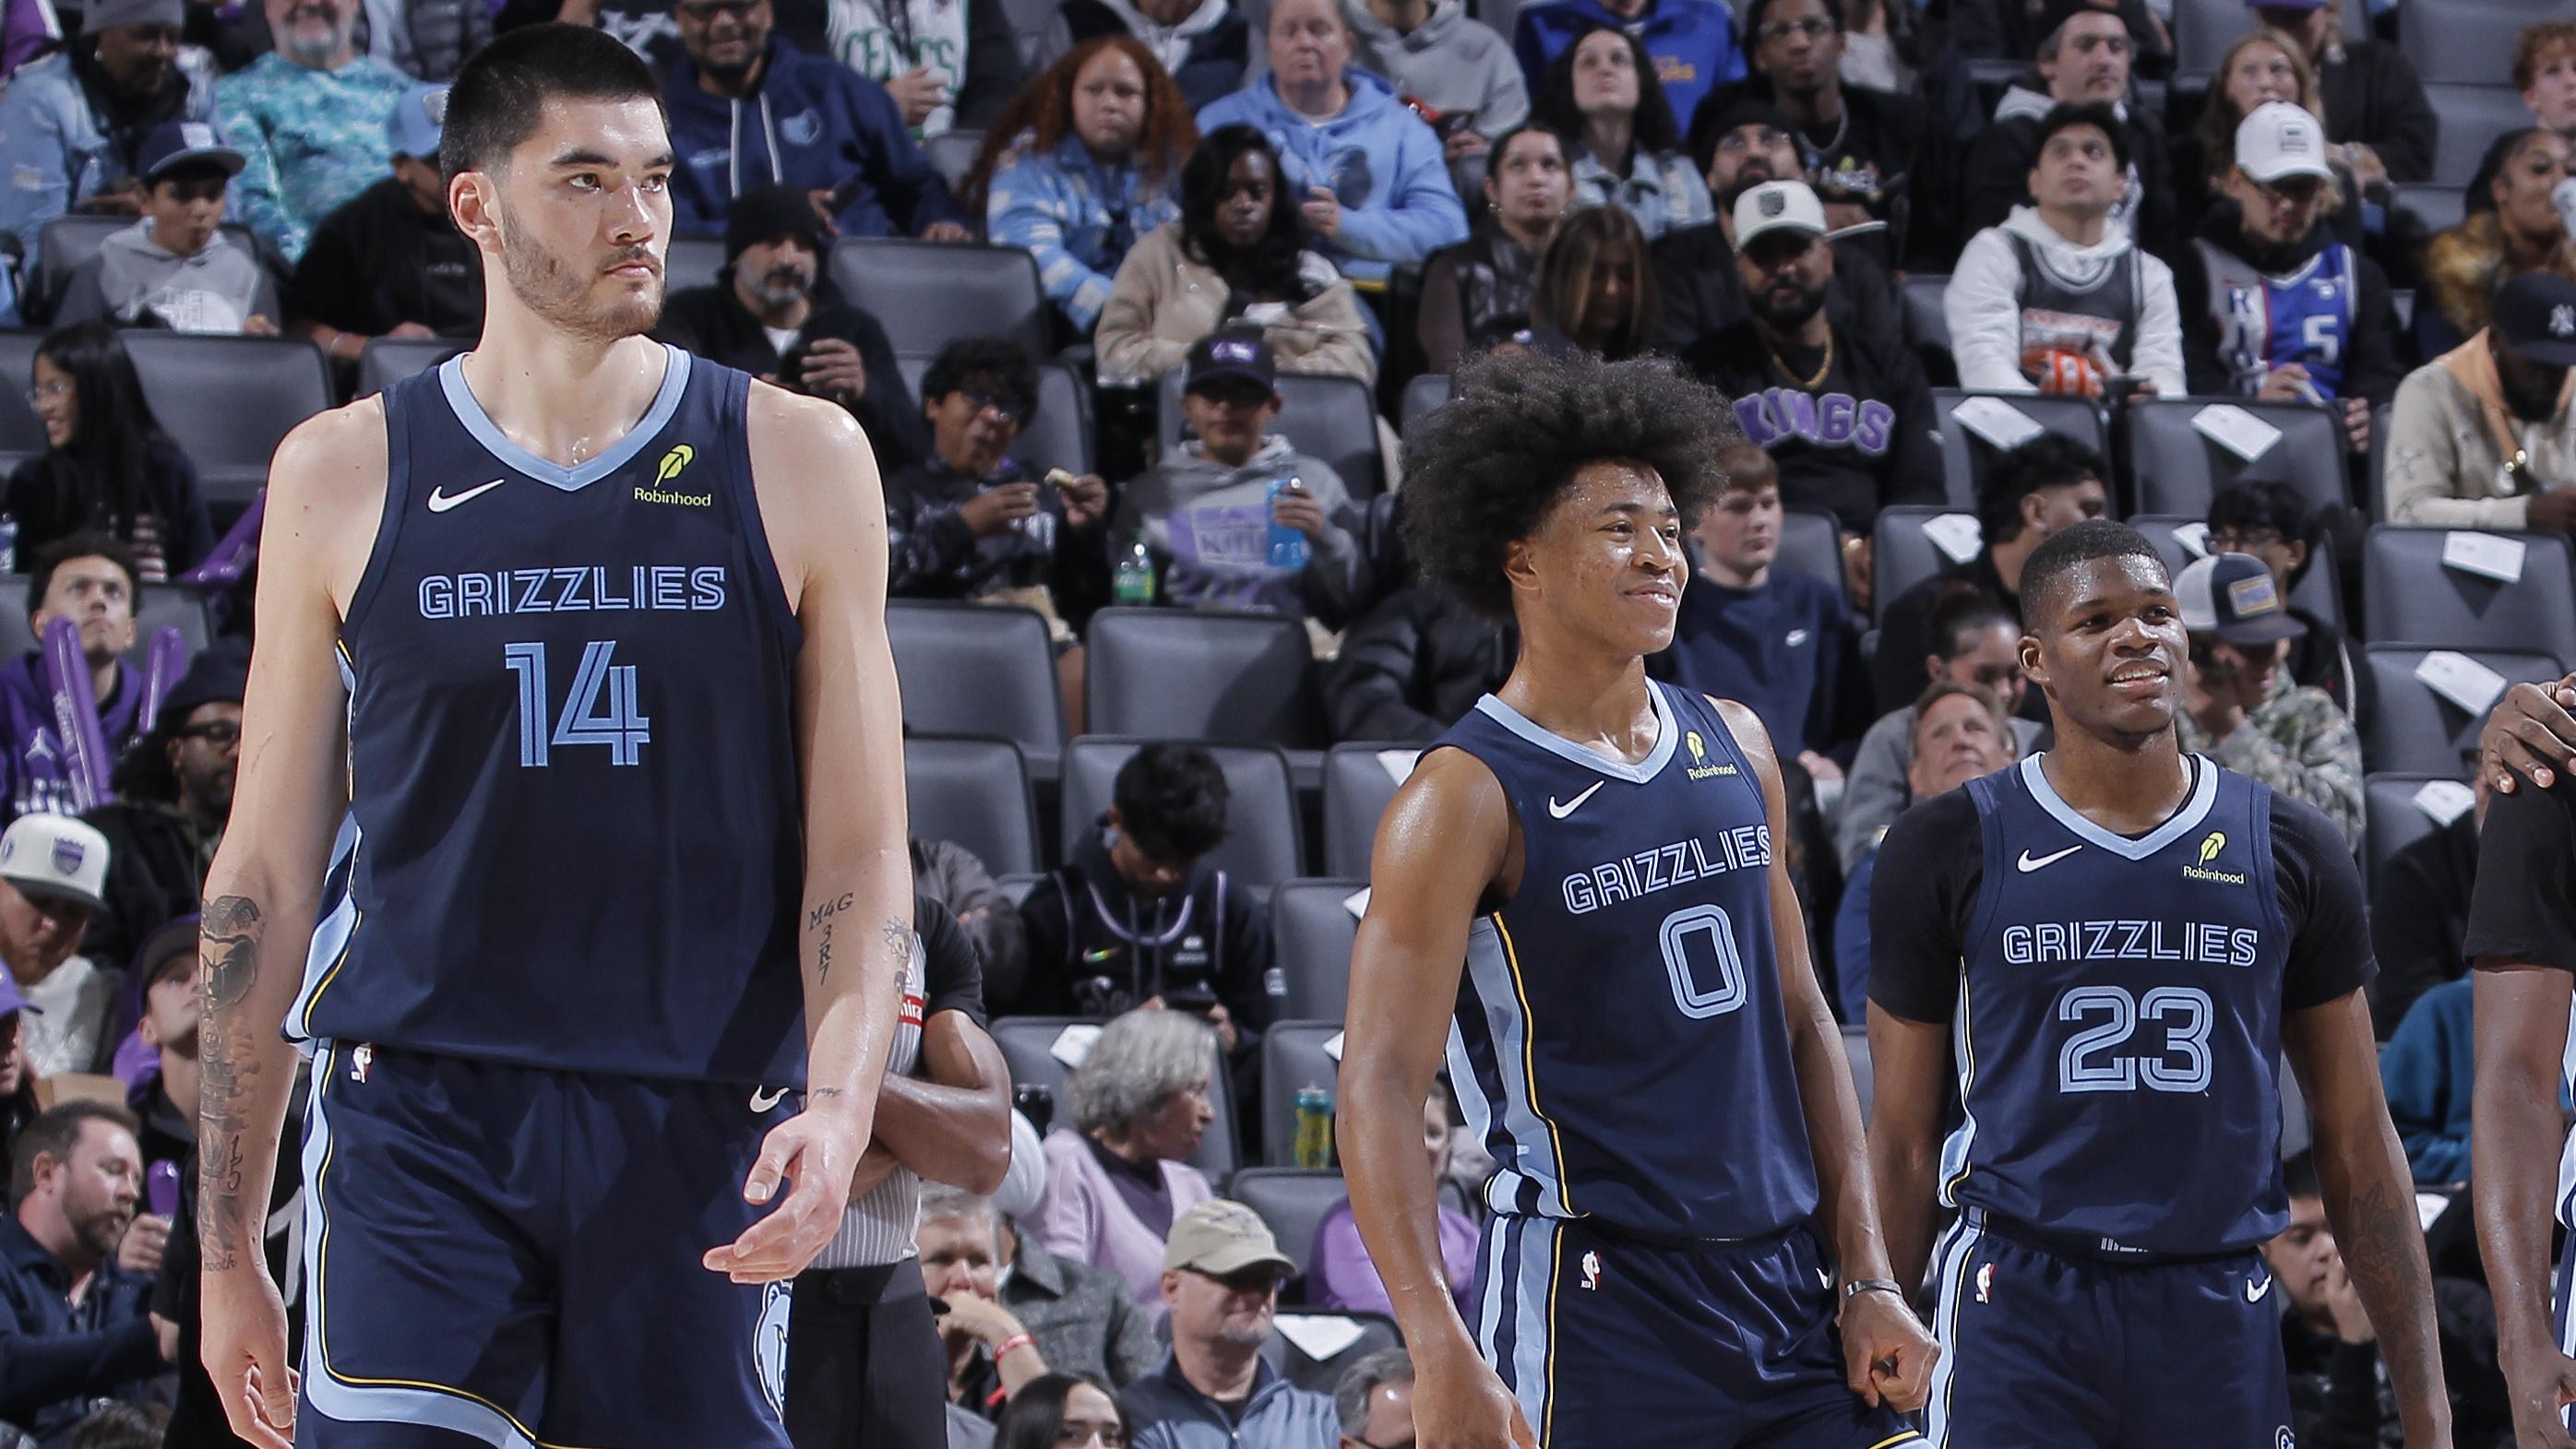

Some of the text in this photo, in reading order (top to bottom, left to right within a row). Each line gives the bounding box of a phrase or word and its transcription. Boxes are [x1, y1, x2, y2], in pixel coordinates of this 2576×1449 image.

[2303, 315, 2338, 364] 5
[1732, 386, 1897, 457] KINGS
[634, 487, 711, 506] Robinhood
[418, 566, 725, 619] GRIZZLIES
[505, 640, 650, 766] 14
[1687, 763, 1737, 780] Robinhood
[1562, 825, 1771, 915] GRIZZLIES
[2183, 865, 2245, 885] Robinhood
[1659, 904, 1747, 1019] 0
[2003, 920, 2258, 967] GRIZZLIES
[2059, 985, 2213, 1094] 23
